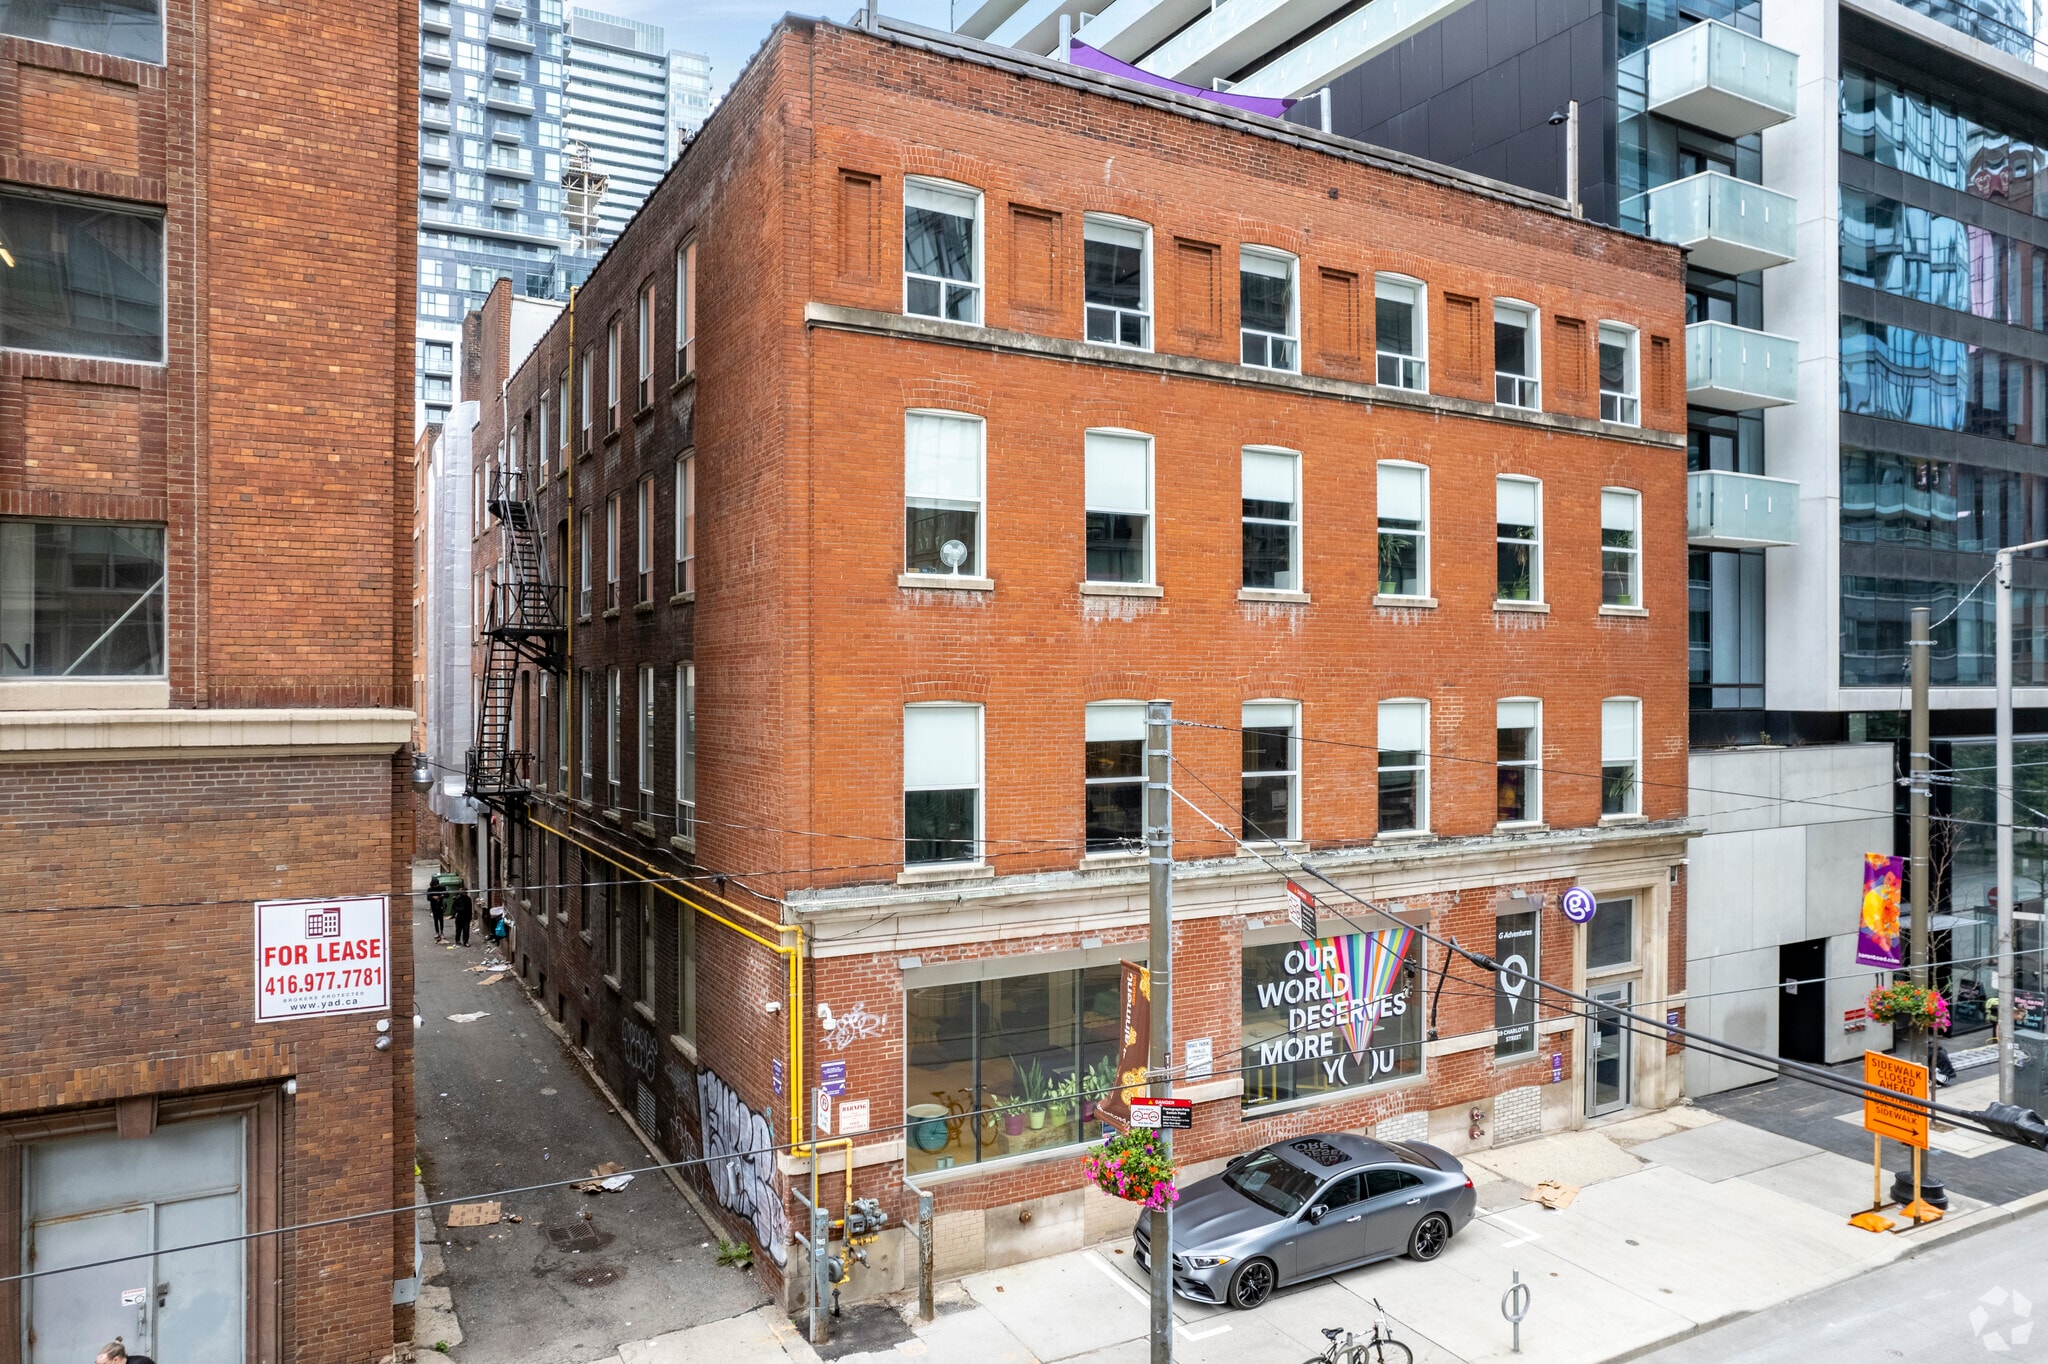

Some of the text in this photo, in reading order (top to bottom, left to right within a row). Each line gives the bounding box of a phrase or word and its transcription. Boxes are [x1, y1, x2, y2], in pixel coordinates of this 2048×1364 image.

[1498, 929, 1533, 940] G Adventures
[264, 938, 381, 968] FOR LEASE
[1284, 946, 1337, 975] OUR
[265, 966, 382, 996] 416.977.7781
[1257, 973, 1349, 1009] WORLD
[283, 991, 365, 1003] BROKERS PROTECTED
[290, 998, 358, 1011] www.yad.ca
[1288, 992, 1407, 1033] DESERVES
[1503, 1025, 1529, 1036] CHARLOTTE
[1259, 1031, 1334, 1066] MORE
[1871, 1058, 1922, 1081] SIDEWALK
[1877, 1069, 1916, 1088] CLOSED
[1879, 1080, 1914, 1096] AHEAD
[1875, 1106, 1917, 1125] SIDEWALK
